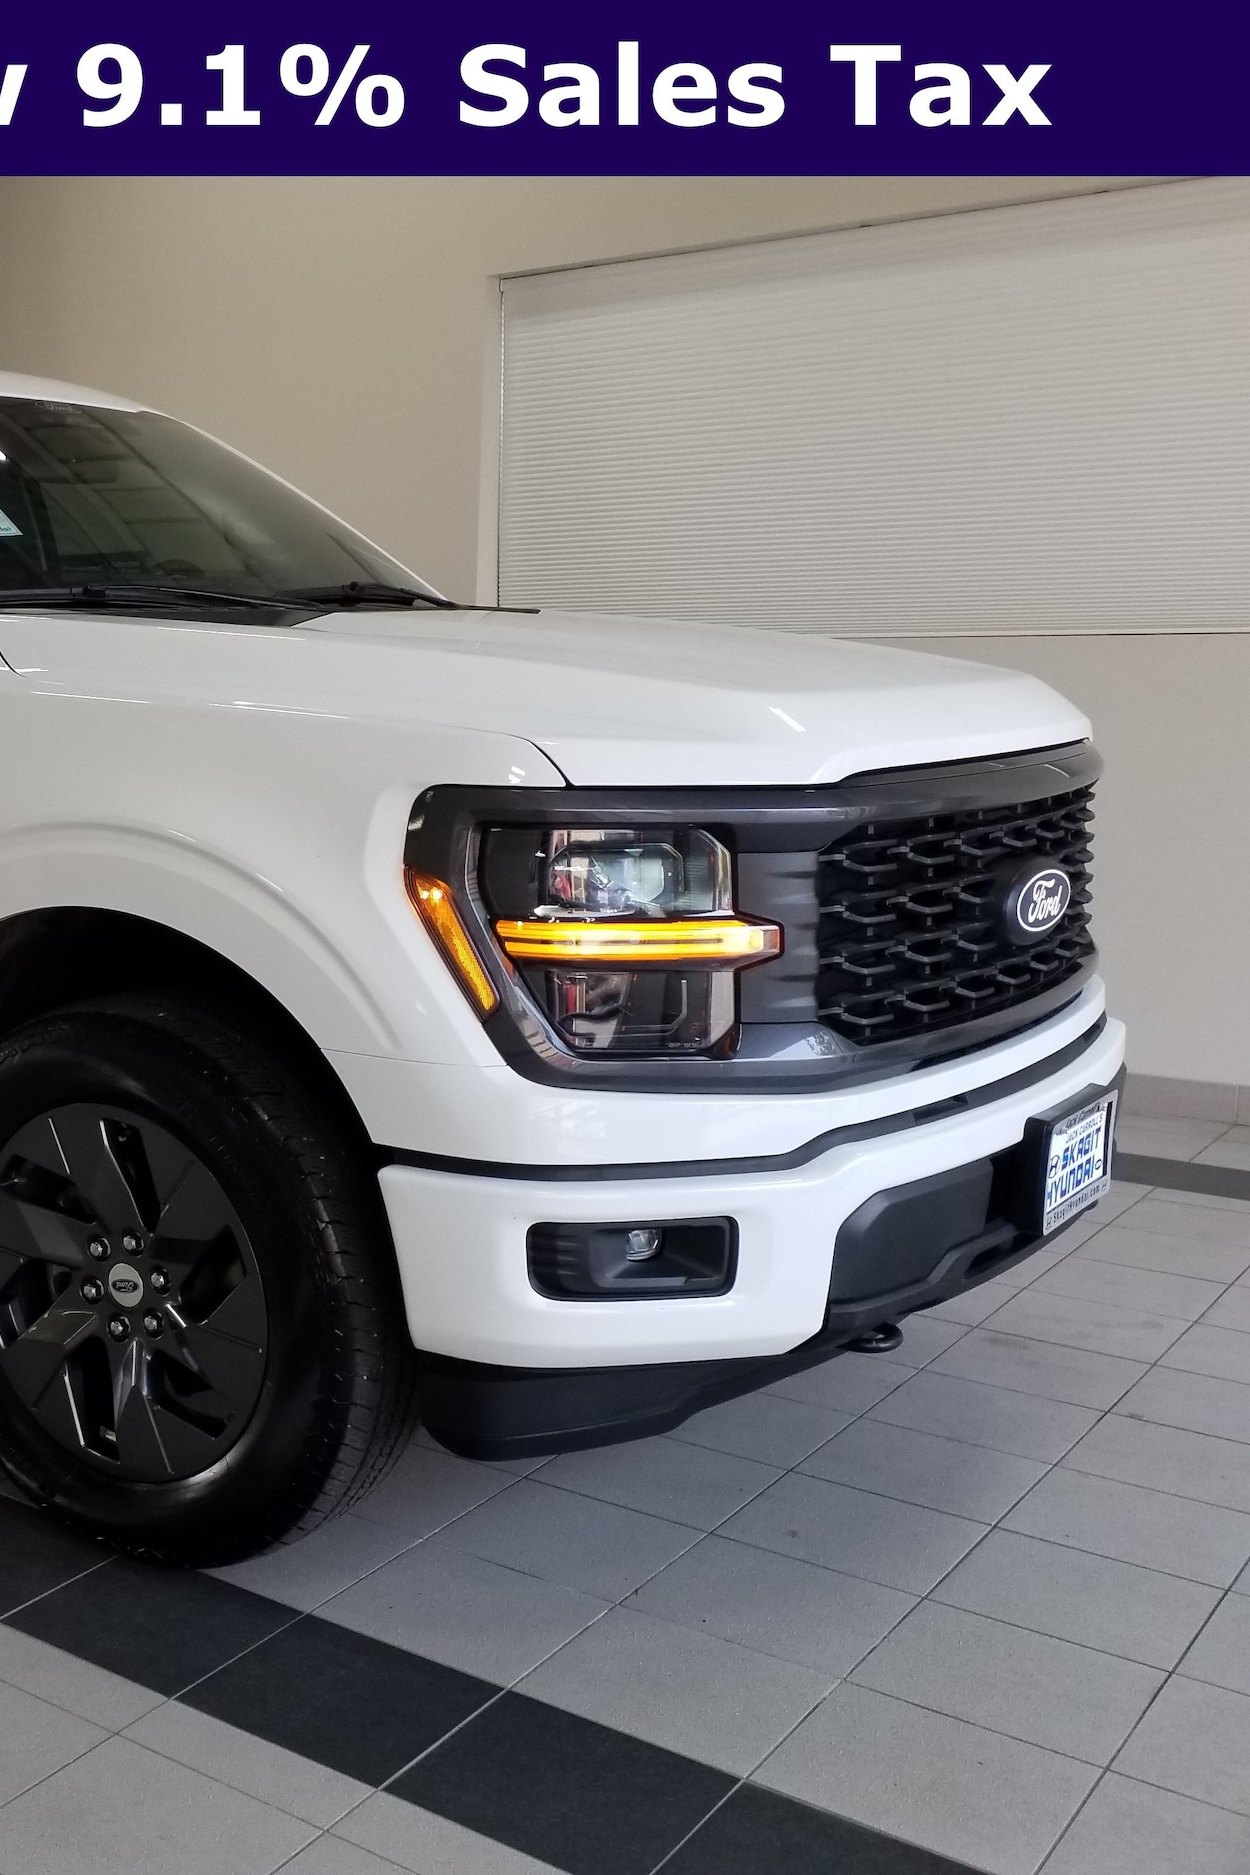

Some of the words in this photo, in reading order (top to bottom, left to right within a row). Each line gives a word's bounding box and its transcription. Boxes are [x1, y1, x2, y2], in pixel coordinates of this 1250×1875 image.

[1061, 1126, 1102, 1171] SKAGIT
[1046, 1154, 1095, 1209] HYUNDAI
[115, 1281, 135, 1292] Ford
